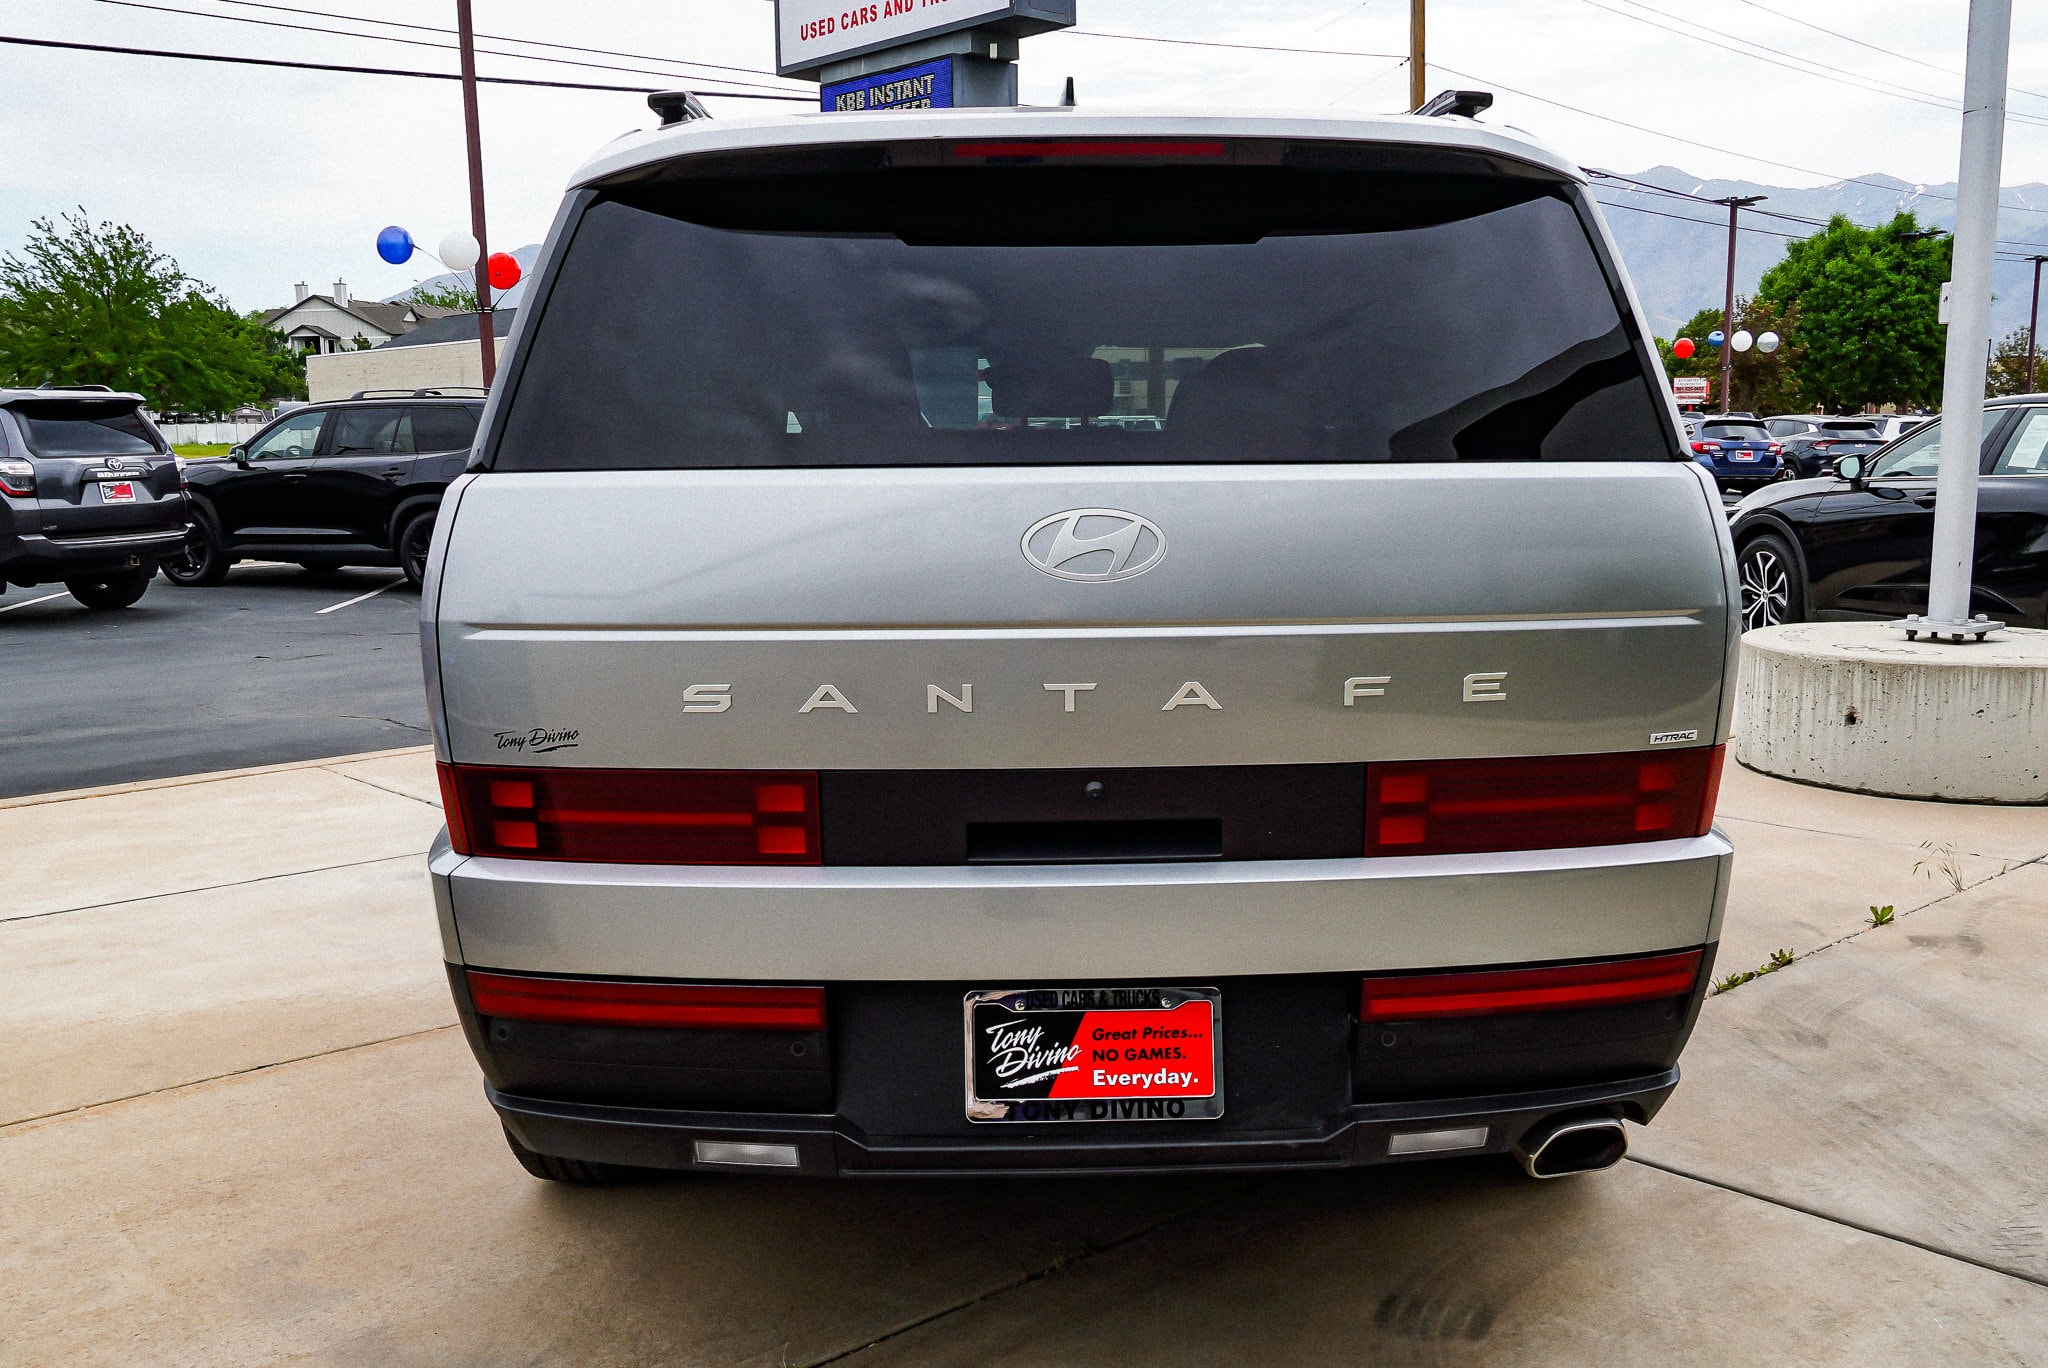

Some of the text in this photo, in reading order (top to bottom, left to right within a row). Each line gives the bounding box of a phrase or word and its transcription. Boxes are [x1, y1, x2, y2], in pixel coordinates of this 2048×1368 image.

[800, 0, 914, 41] USED CARS AND
[836, 90, 866, 111] KBB
[869, 74, 935, 107] INSTANT
[682, 671, 1508, 714] SANTA FE
[494, 727, 581, 752] Tony Divino
[1653, 732, 1695, 742] HTRAC
[1025, 989, 1161, 1009] USED CARS & TRUCKS
[986, 1019, 1045, 1053] Tony
[1092, 1026, 1204, 1042] Great Prices...
[986, 1042, 1082, 1077] Divino
[1092, 1047, 1187, 1062] NO GAMES.
[1093, 1068, 1199, 1090] Everyday.
[1008, 1099, 1186, 1120] TONY DIVINO
